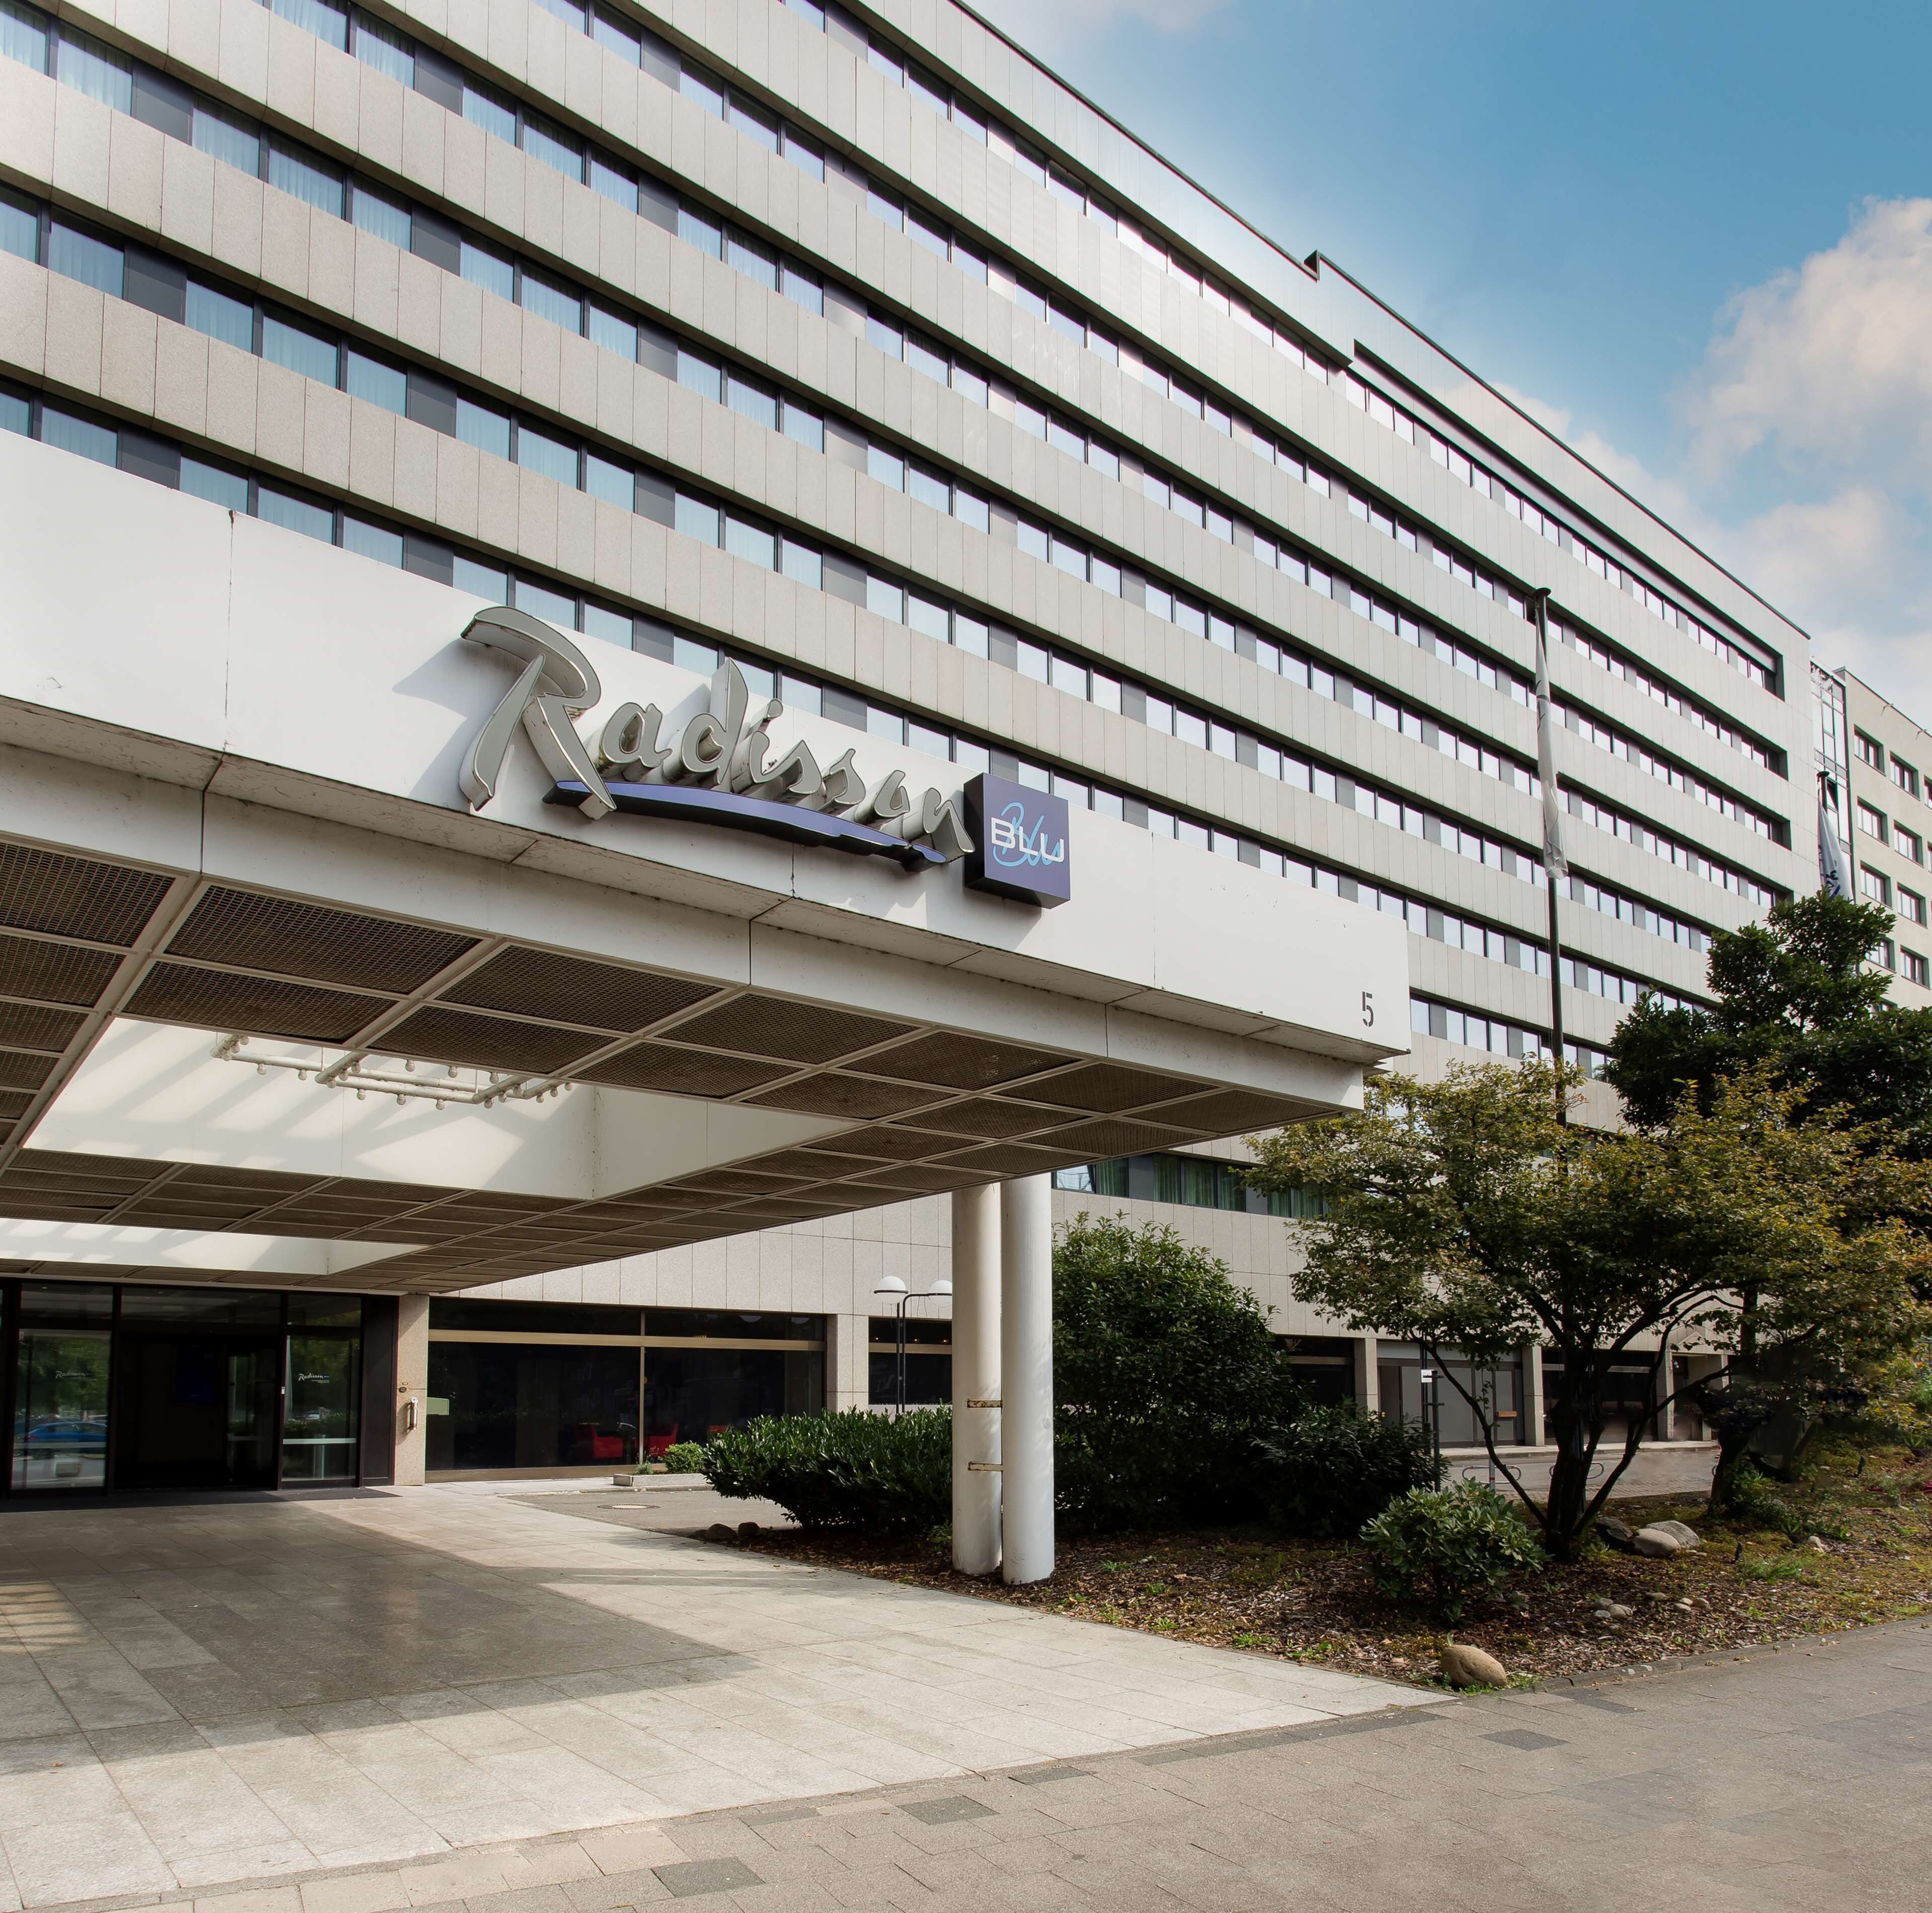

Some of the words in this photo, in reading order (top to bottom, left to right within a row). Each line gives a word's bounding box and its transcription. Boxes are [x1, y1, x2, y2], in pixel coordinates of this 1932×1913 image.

[460, 606, 975, 854] Radisson
[991, 817, 1065, 862] BLU
[1361, 991, 1374, 1027] 5
